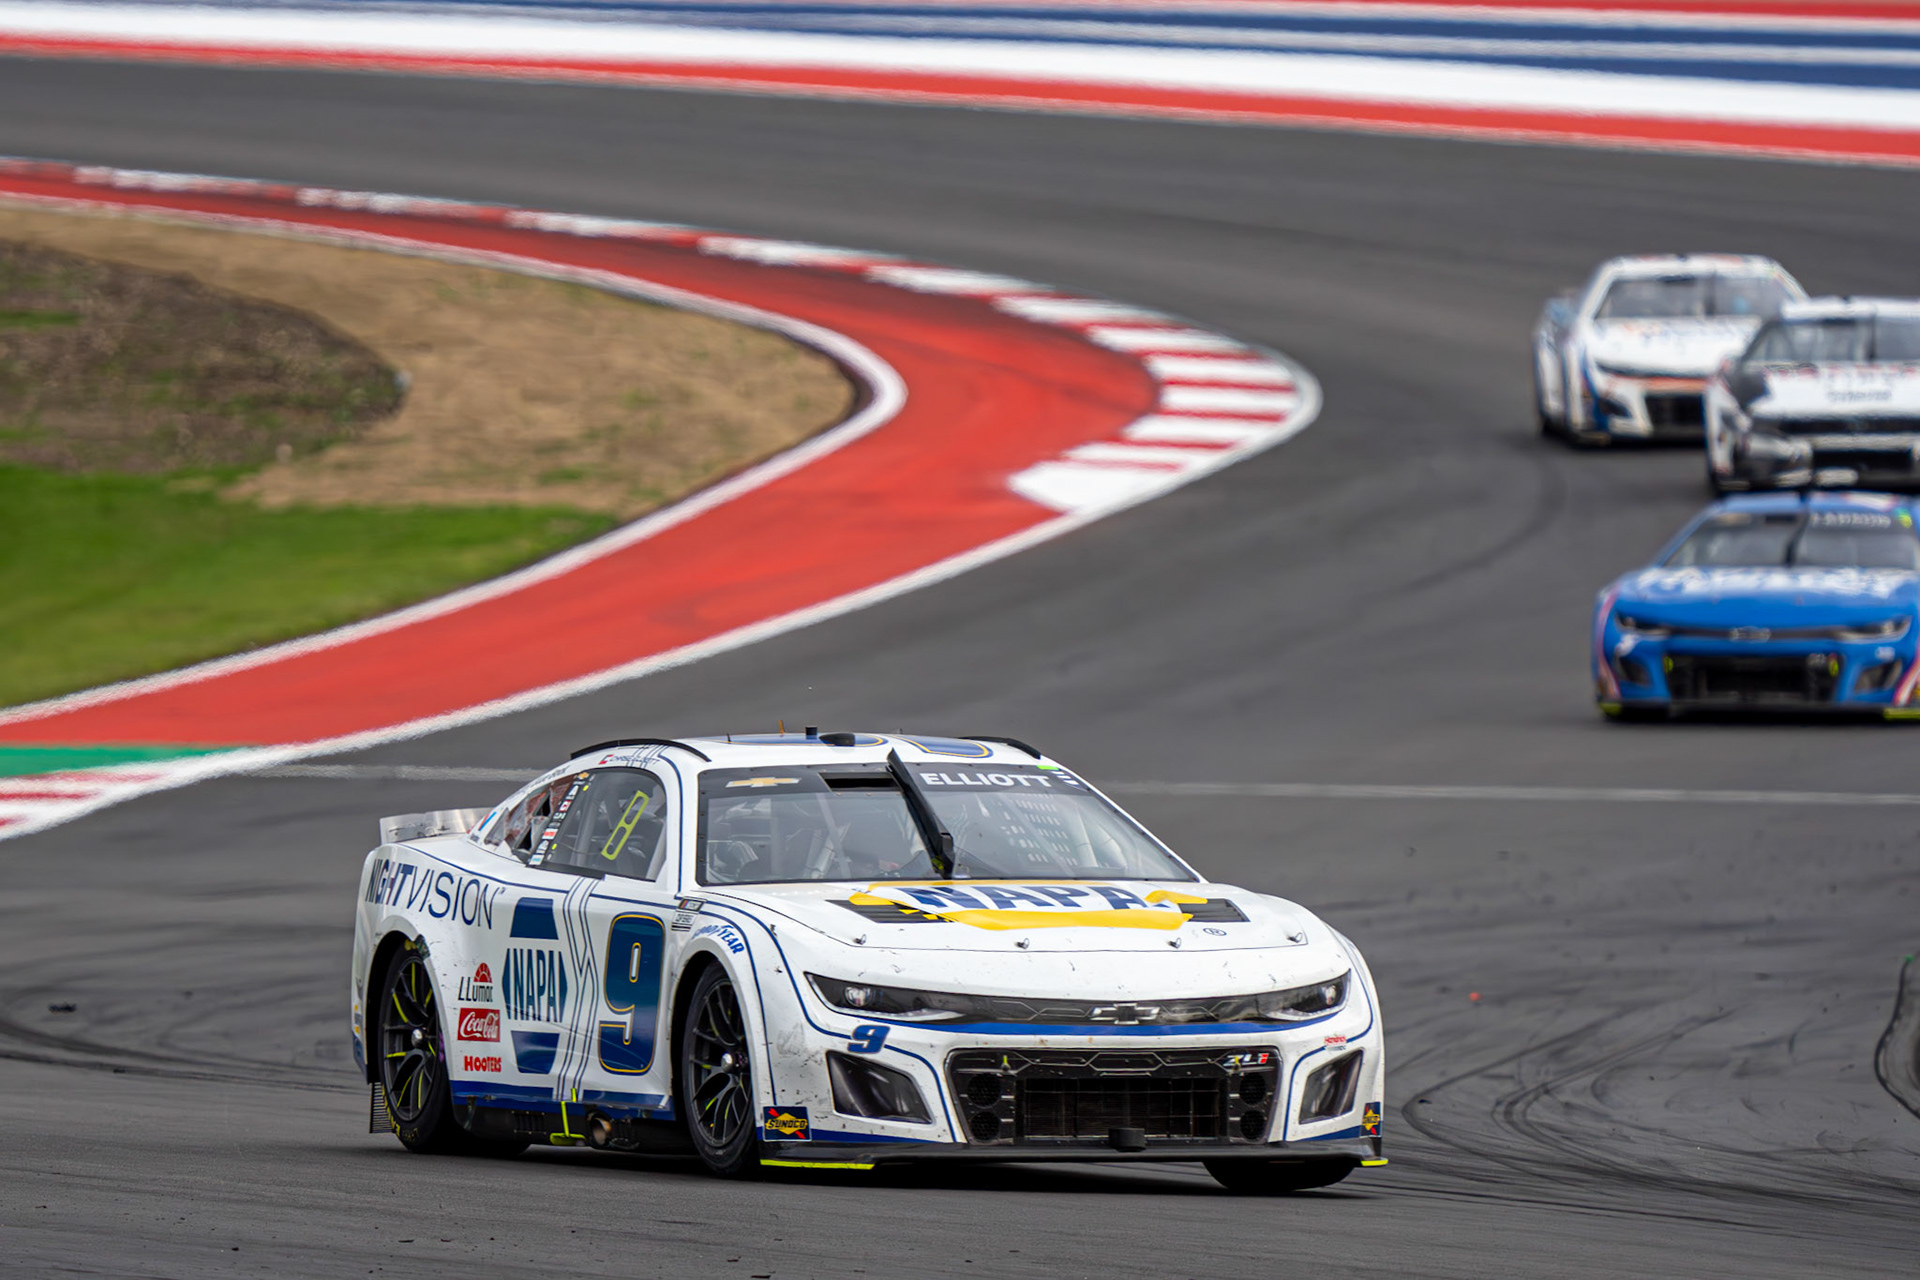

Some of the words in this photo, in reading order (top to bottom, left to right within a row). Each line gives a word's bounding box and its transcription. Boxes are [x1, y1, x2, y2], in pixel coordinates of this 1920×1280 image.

[919, 773, 1052, 788] ELLIOTT
[364, 858, 500, 930] NIGHTVISION
[901, 885, 1171, 910] NAPA
[513, 948, 558, 1023] NAPA
[597, 911, 667, 1077] 9
[847, 1024, 890, 1055] 9
[463, 1055, 502, 1073] HOOTERS
[766, 1118, 808, 1129] SUNOCO
